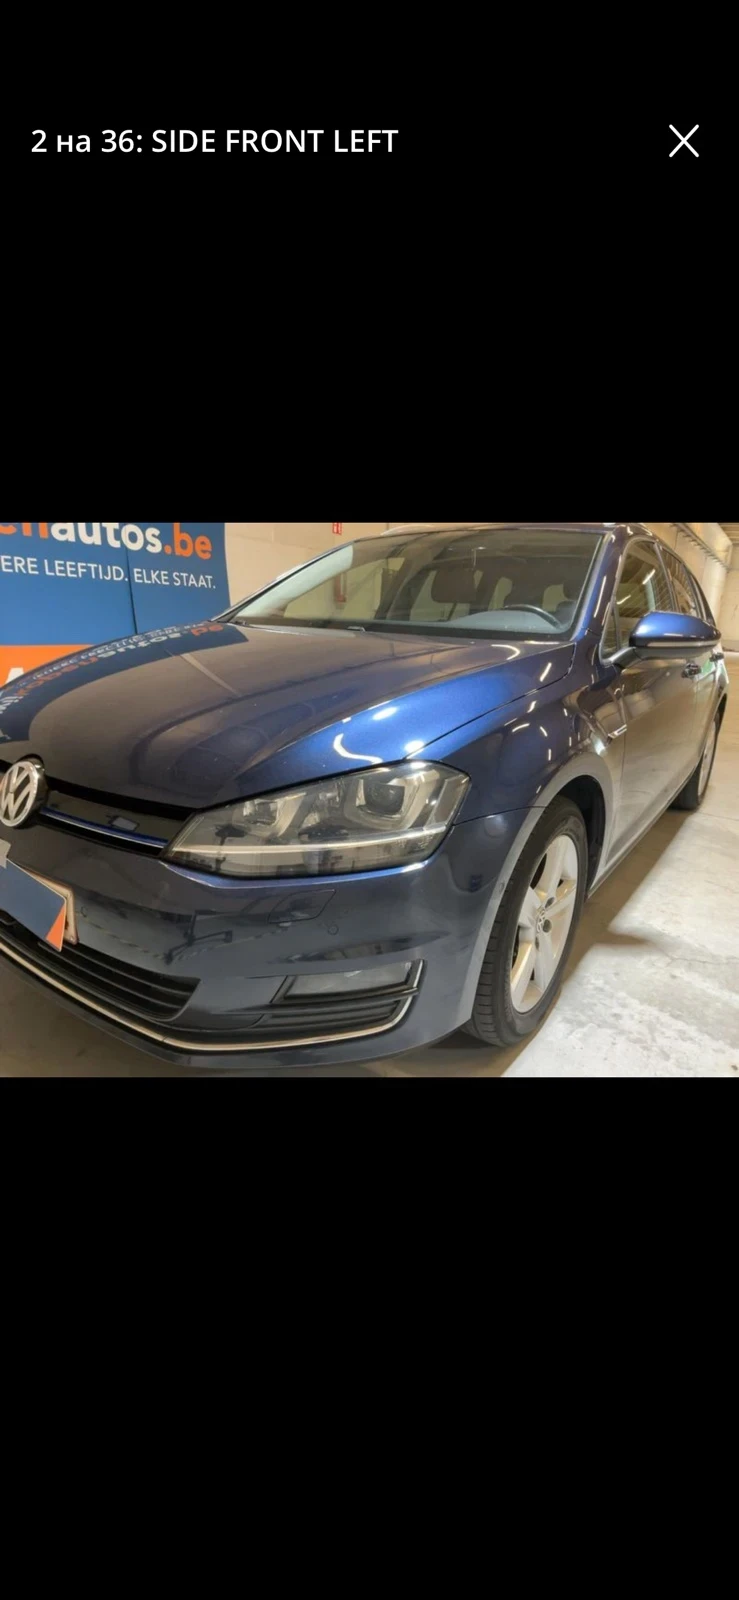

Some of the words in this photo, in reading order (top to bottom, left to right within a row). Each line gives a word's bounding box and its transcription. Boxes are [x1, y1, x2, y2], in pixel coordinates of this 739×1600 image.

[0, 555, 39, 574] ERE
[44, 559, 129, 582] LEEFTIJD.
[133, 568, 170, 586] ELKE
[172, 572, 216, 589] STAAT.
[0, 761, 38, 826] VW
